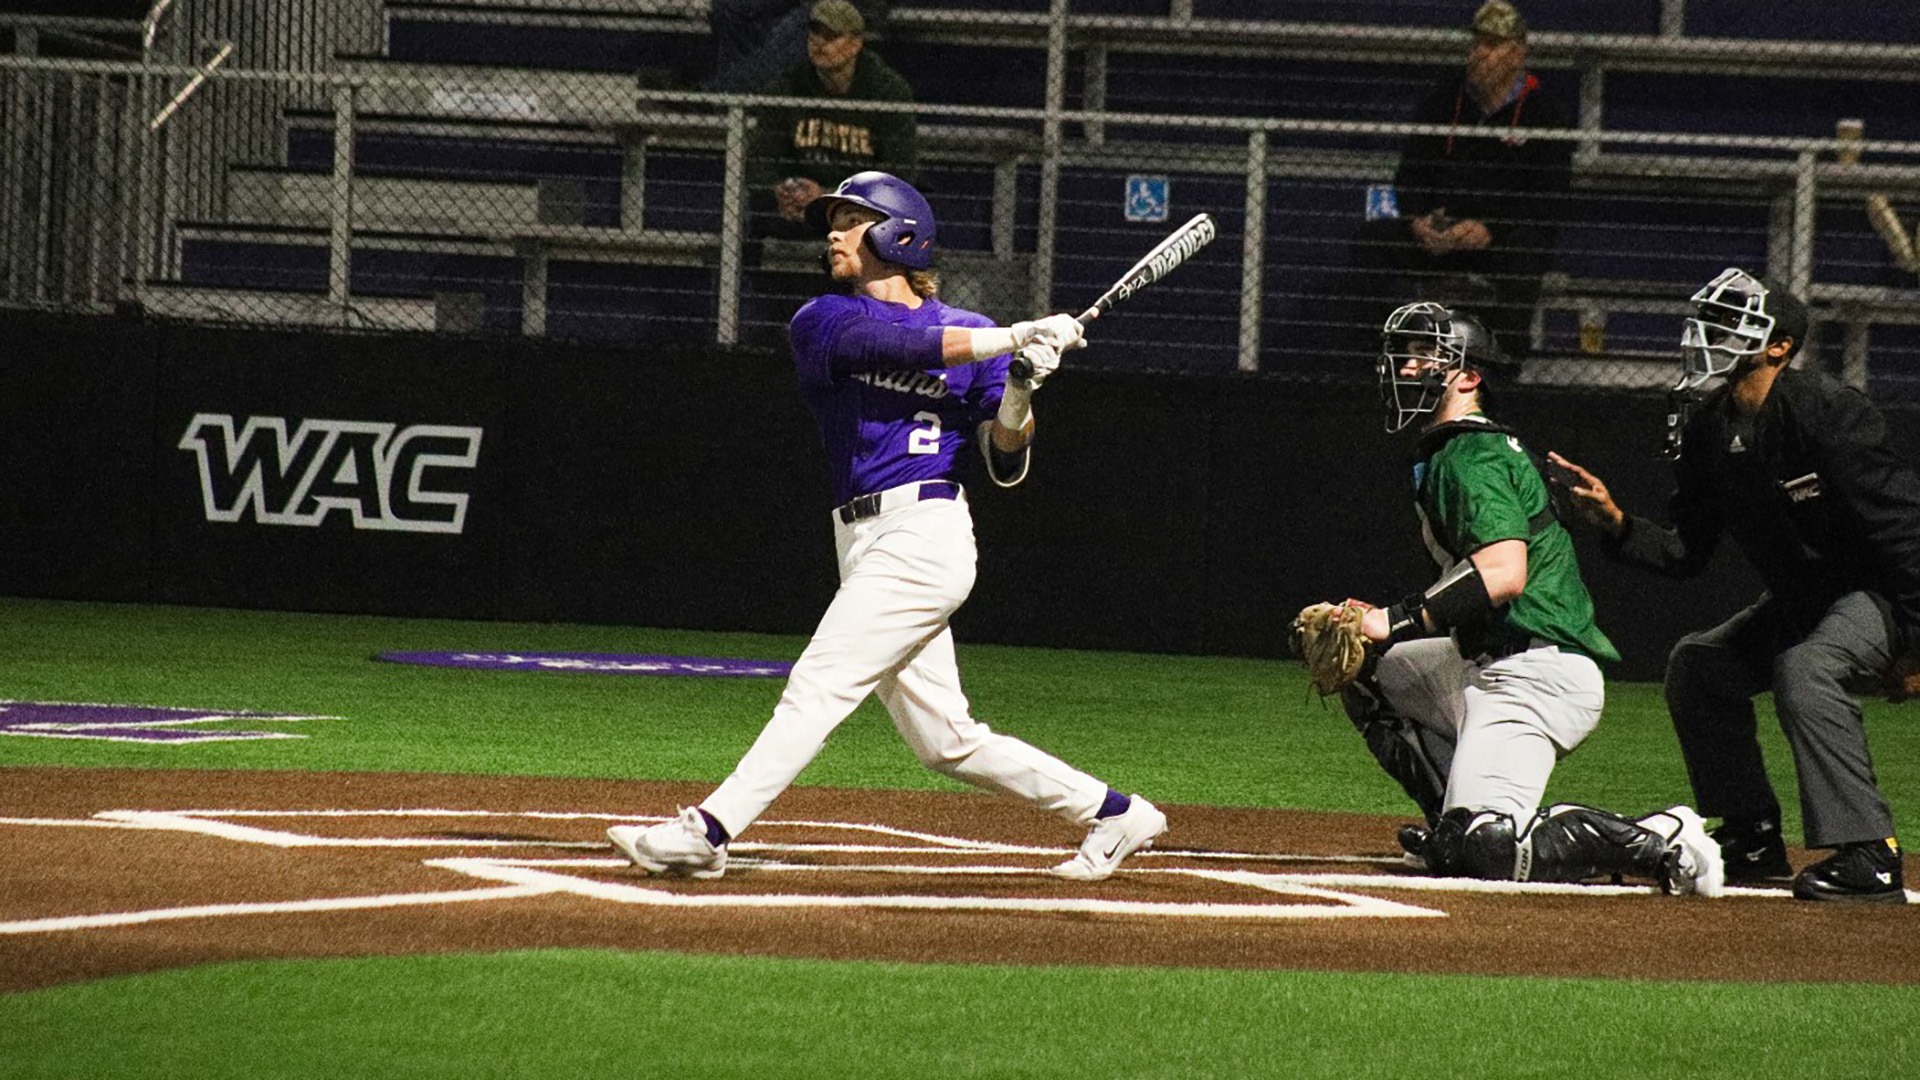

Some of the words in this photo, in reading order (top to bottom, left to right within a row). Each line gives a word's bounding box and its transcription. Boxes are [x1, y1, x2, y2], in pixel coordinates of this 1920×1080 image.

[1148, 219, 1215, 282] marucci
[908, 410, 942, 454] 2
[178, 413, 483, 534] WAC
[1517, 848, 1530, 882] TON
